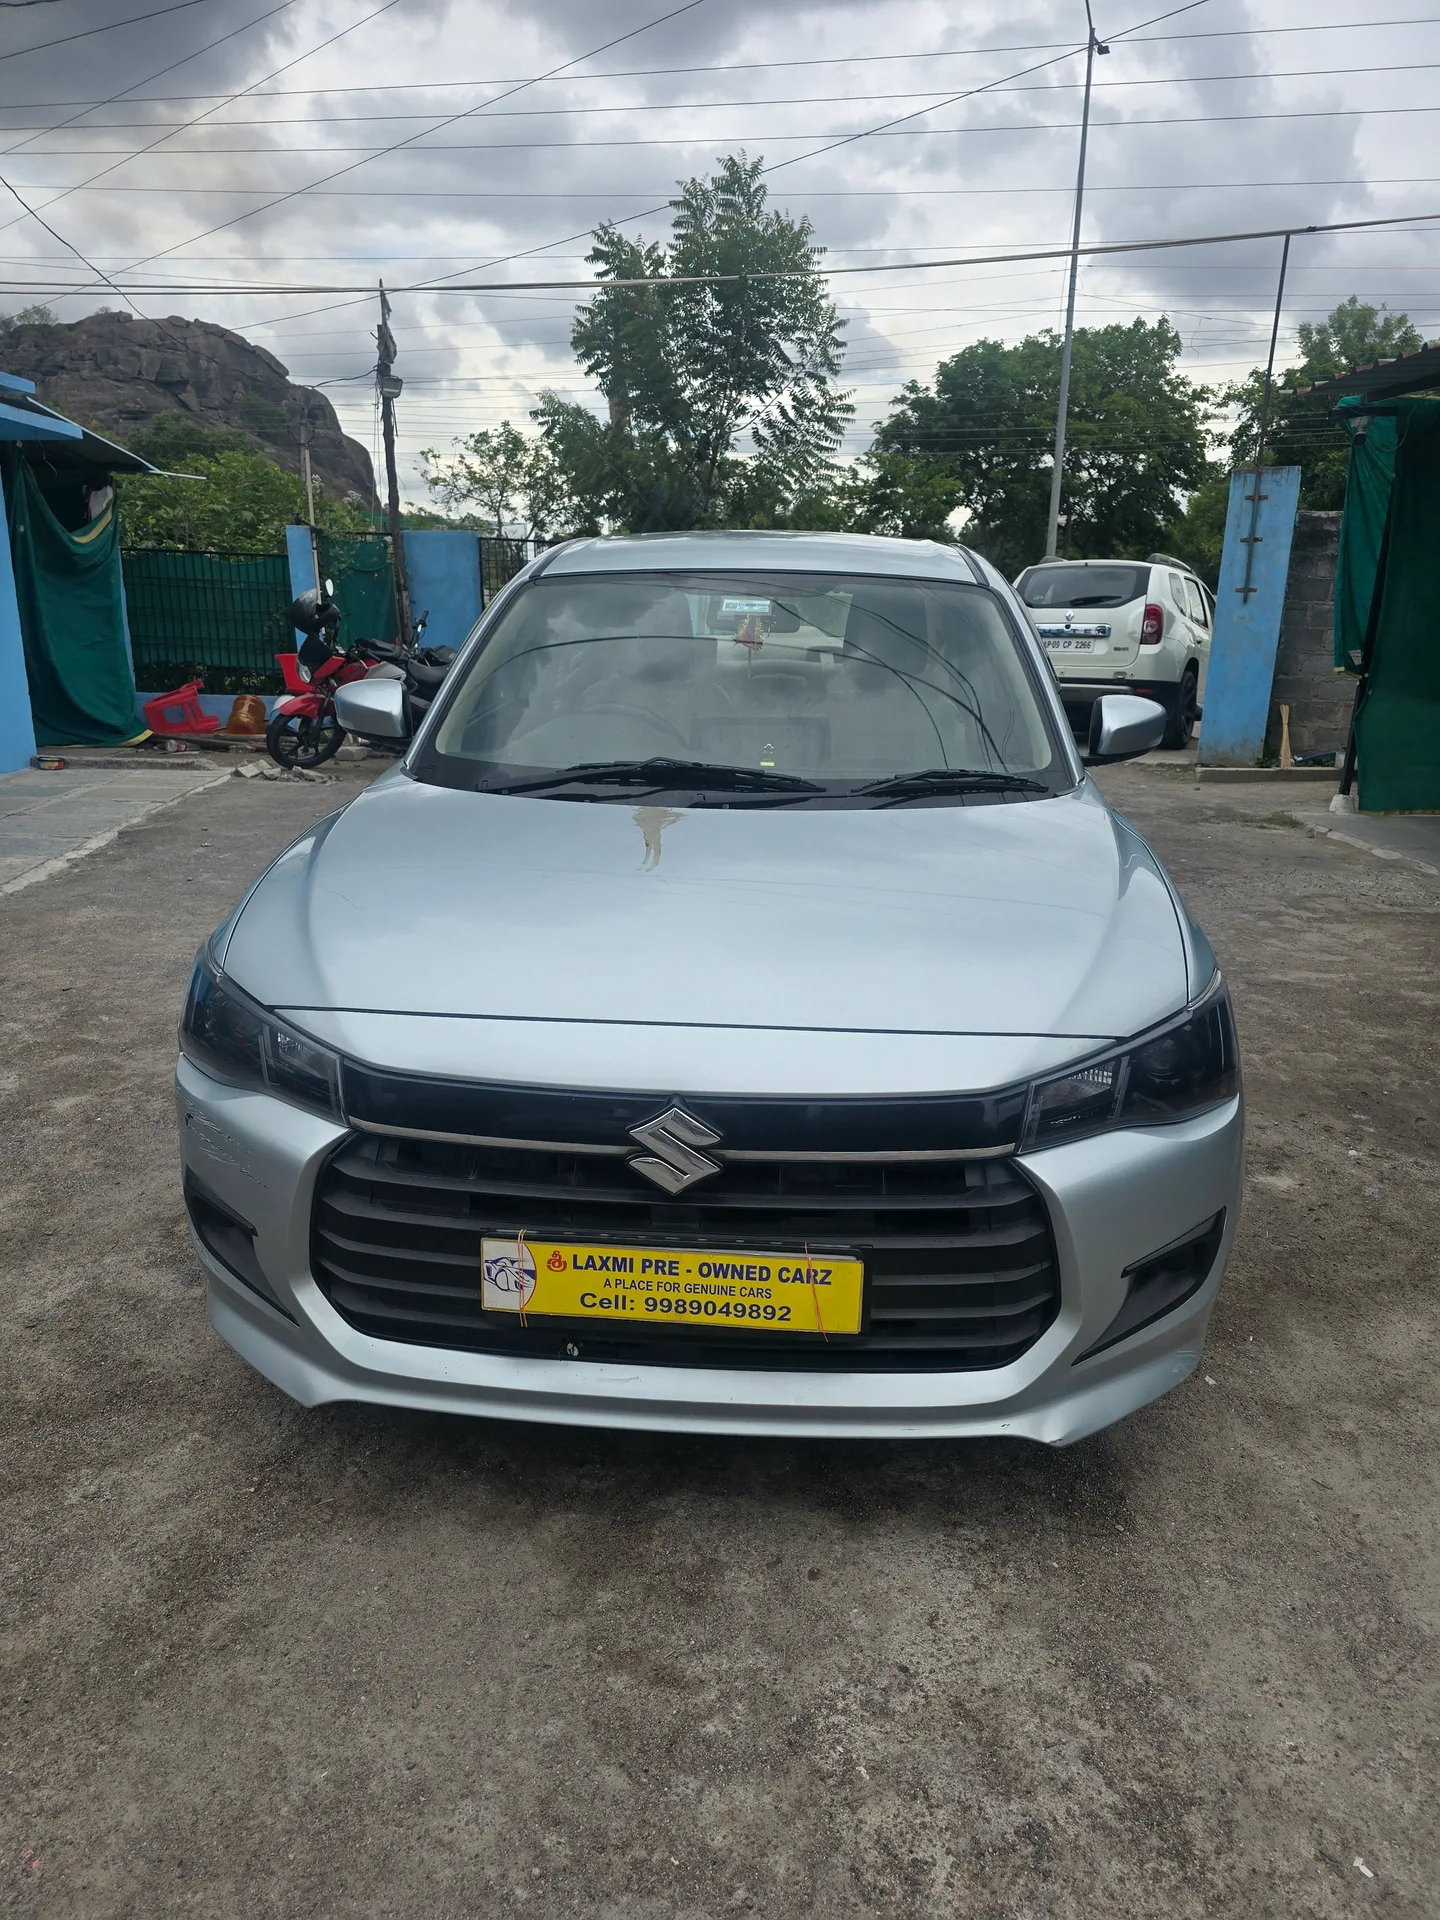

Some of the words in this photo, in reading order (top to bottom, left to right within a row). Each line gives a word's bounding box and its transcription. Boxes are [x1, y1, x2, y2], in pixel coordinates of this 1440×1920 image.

[1063, 640, 1072, 649] CP
[572, 1253, 634, 1273] LAXMI
[641, 1258, 680, 1276] PRE
[698, 1262, 771, 1282] OWNED
[777, 1266, 832, 1286] CARZ
[603, 1278, 612, 1288] A
[615, 1278, 653, 1291] PLACE
[656, 1281, 681, 1293] FOR
[684, 1283, 736, 1297] GENUINE
[739, 1286, 772, 1299] CARS
[579, 1292, 635, 1311] Cell:
[644, 1296, 792, 1322] 9989049892
